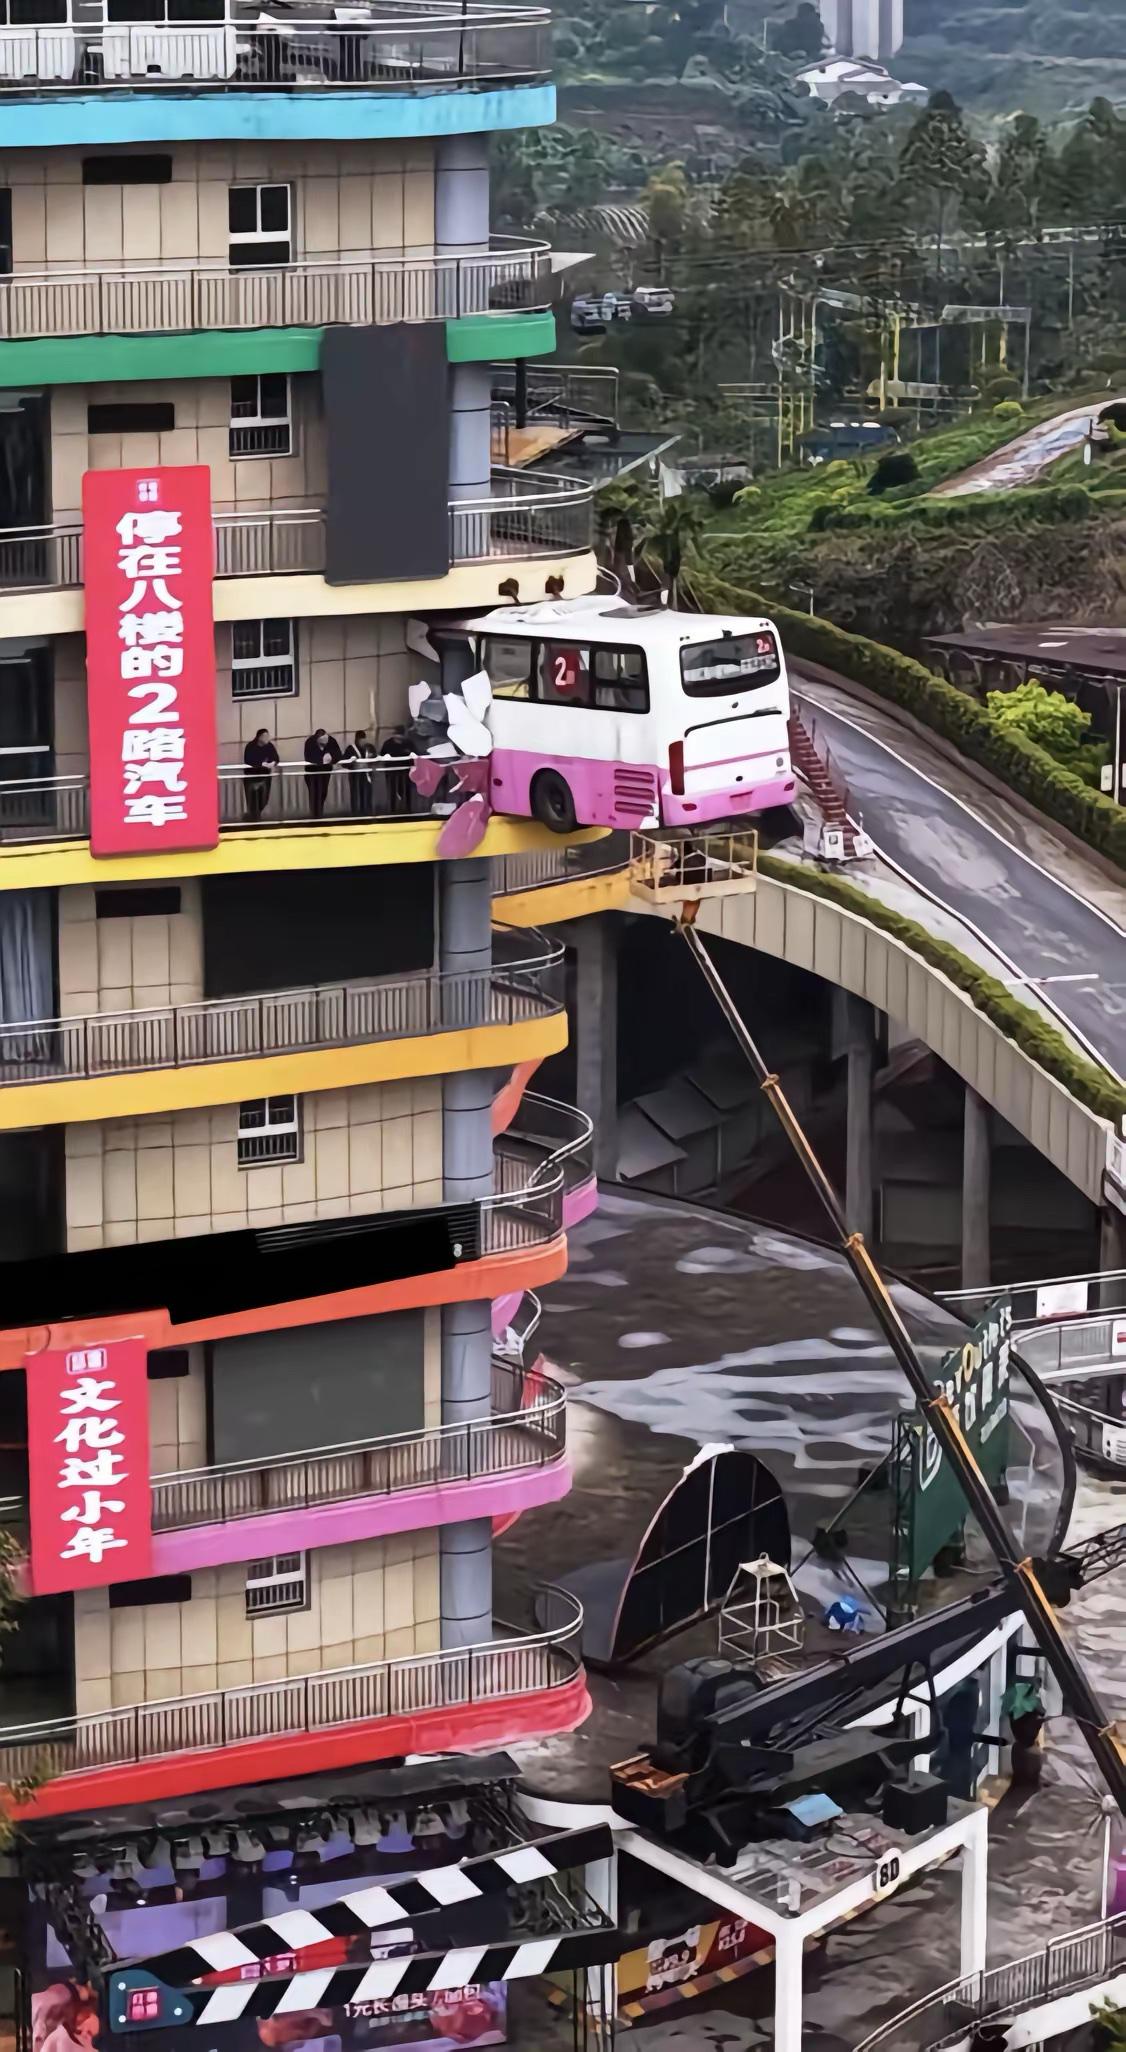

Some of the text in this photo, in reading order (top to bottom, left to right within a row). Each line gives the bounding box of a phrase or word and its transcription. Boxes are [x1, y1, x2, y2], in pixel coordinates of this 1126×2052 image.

[115, 510, 188, 827] 停在八楼的2路汽车
[53, 1377, 129, 1563] 文化过小年
